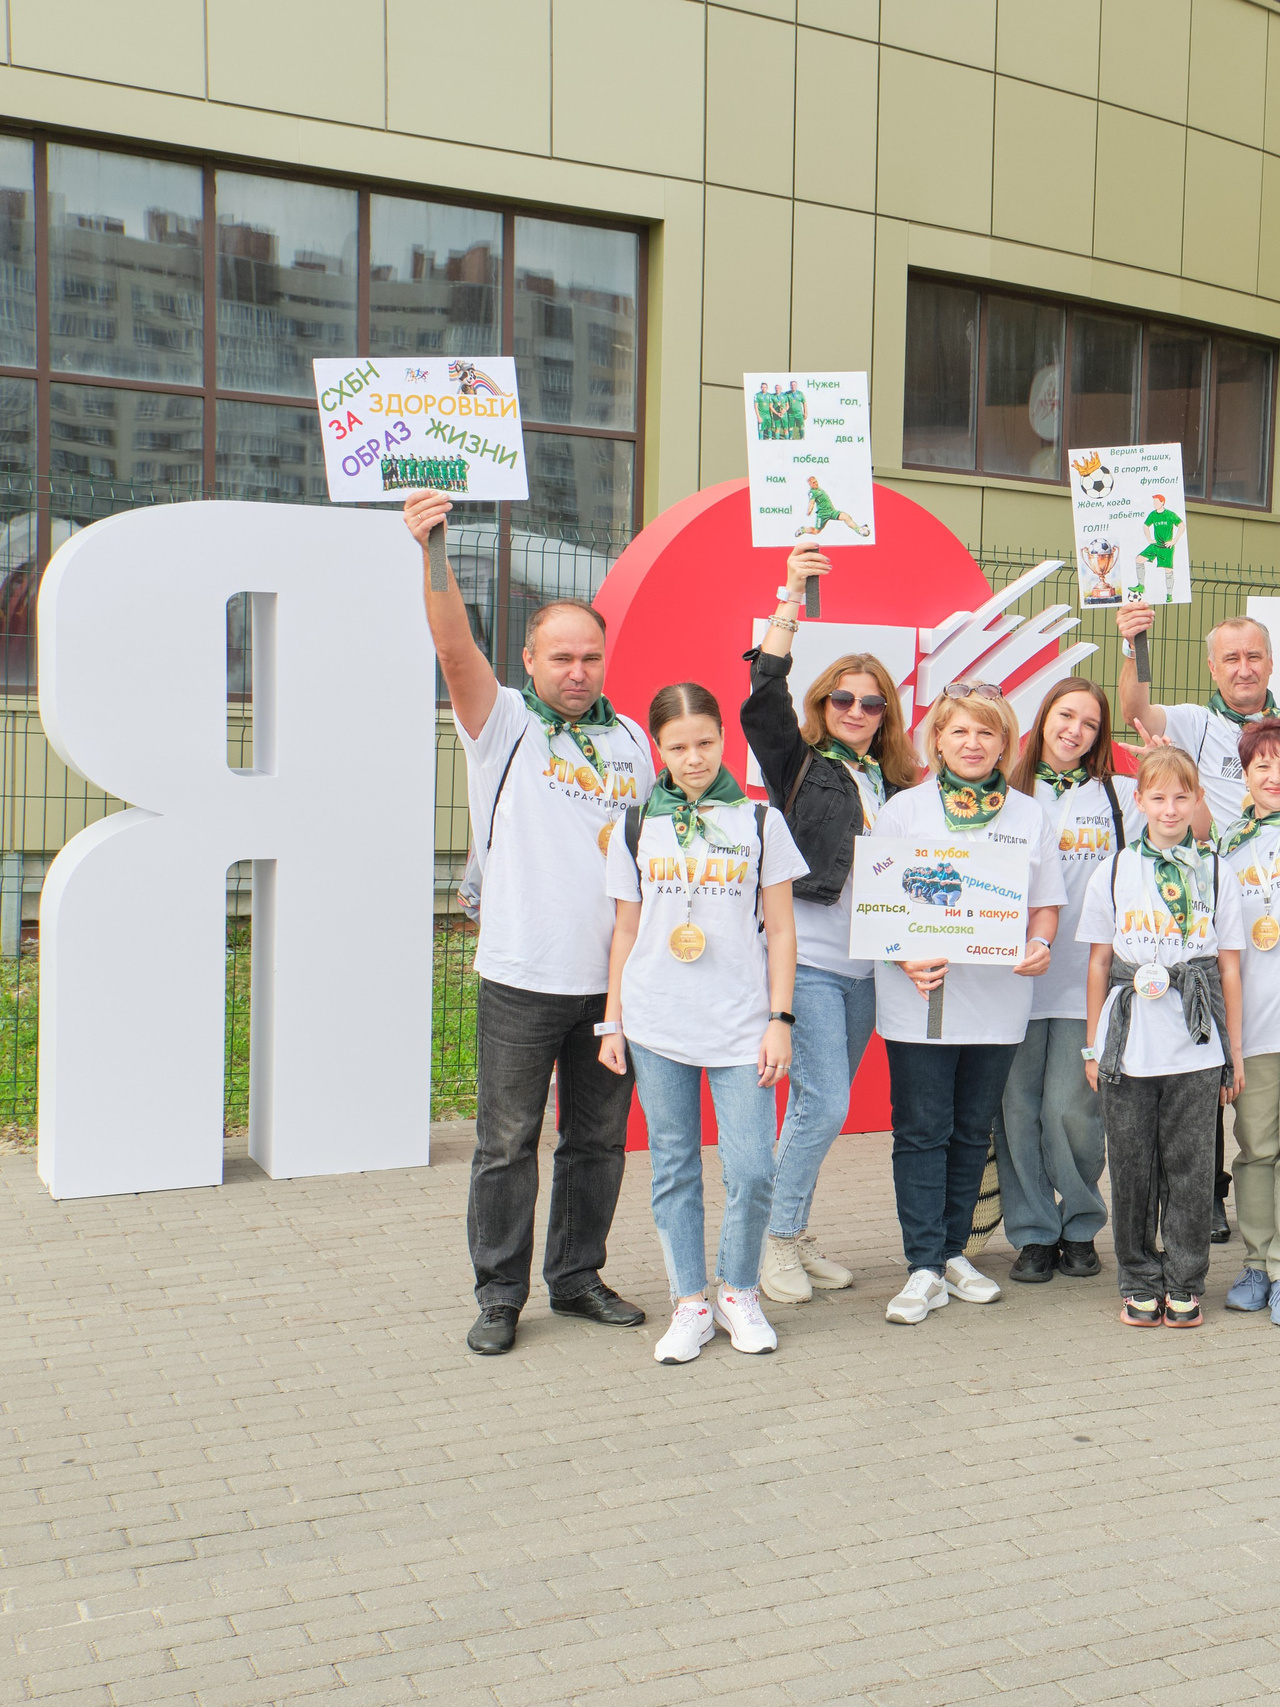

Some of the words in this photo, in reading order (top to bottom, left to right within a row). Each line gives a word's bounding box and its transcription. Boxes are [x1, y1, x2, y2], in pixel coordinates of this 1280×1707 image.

[321, 360, 381, 412] СХБН
[807, 379, 840, 393] Нужен
[840, 397, 862, 407] гол,
[328, 410, 363, 440] ЗА
[369, 392, 517, 419] ЗДОРОВЫЙ
[813, 418, 845, 427] нужно
[835, 435, 853, 443] два
[342, 420, 412, 477] ОБРАЗ
[425, 418, 518, 469] ЖИЗНИ
[1110, 448, 1138, 456] Верим
[793, 454, 830, 464] победа
[1141, 454, 1172, 462] наших,
[1114, 466, 1120, 474] В
[1121, 465, 1151, 474] спорт,
[766, 475, 787, 484] нам
[1140, 477, 1179, 486] футбол!
[1077, 501, 1105, 509] Ждем,
[1106, 498, 1131, 507] когда
[759, 505, 793, 515] важна!
[1108, 511, 1146, 520] забьёте
[1083, 523, 1110, 533] ГОЛ!!!
[38, 500, 437, 1200] Я
[914, 848, 928, 858] за
[934, 847, 970, 861] кубок
[872, 856, 895, 876] Мы
[962, 875, 1023, 902] приехали
[856, 902, 911, 916] драться,
[945, 908, 961, 917] ни
[967, 909, 974, 917] в
[979, 909, 1019, 922] какую
[908, 921, 975, 935] Сельхозка
[885, 942, 902, 955] не
[966, 943, 1019, 957] сдастся!
